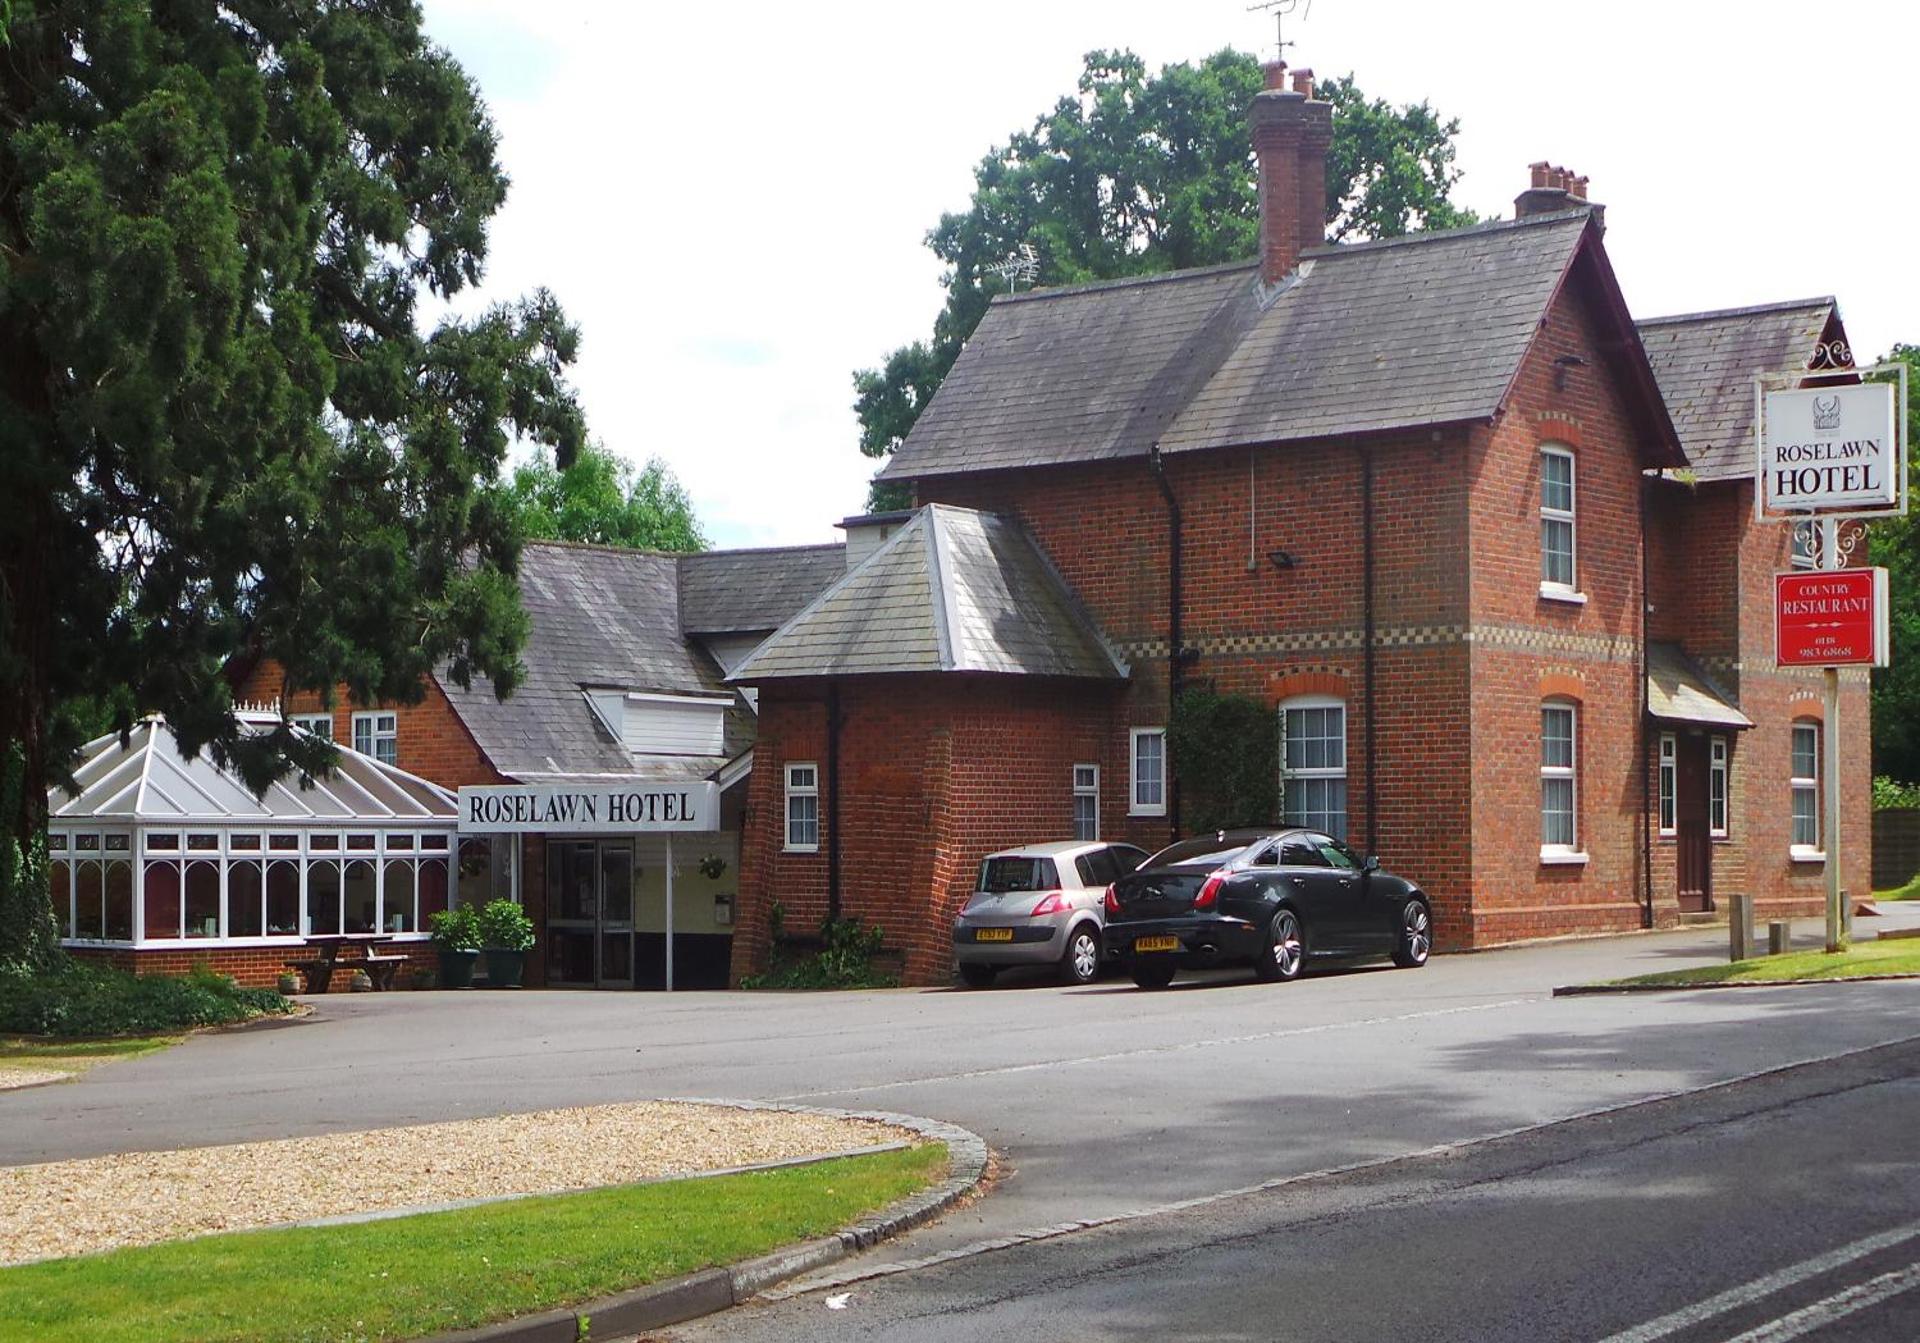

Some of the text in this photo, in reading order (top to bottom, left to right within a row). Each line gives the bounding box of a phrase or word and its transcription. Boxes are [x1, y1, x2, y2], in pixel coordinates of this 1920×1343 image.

[1776, 440, 1881, 462] ROSELAWN
[1776, 464, 1880, 496] HOTEL
[1800, 584, 1849, 596] COUNTRY
[1783, 597, 1869, 614] RESTAURANT
[468, 793, 696, 823] ROSELAWN HOTEL
